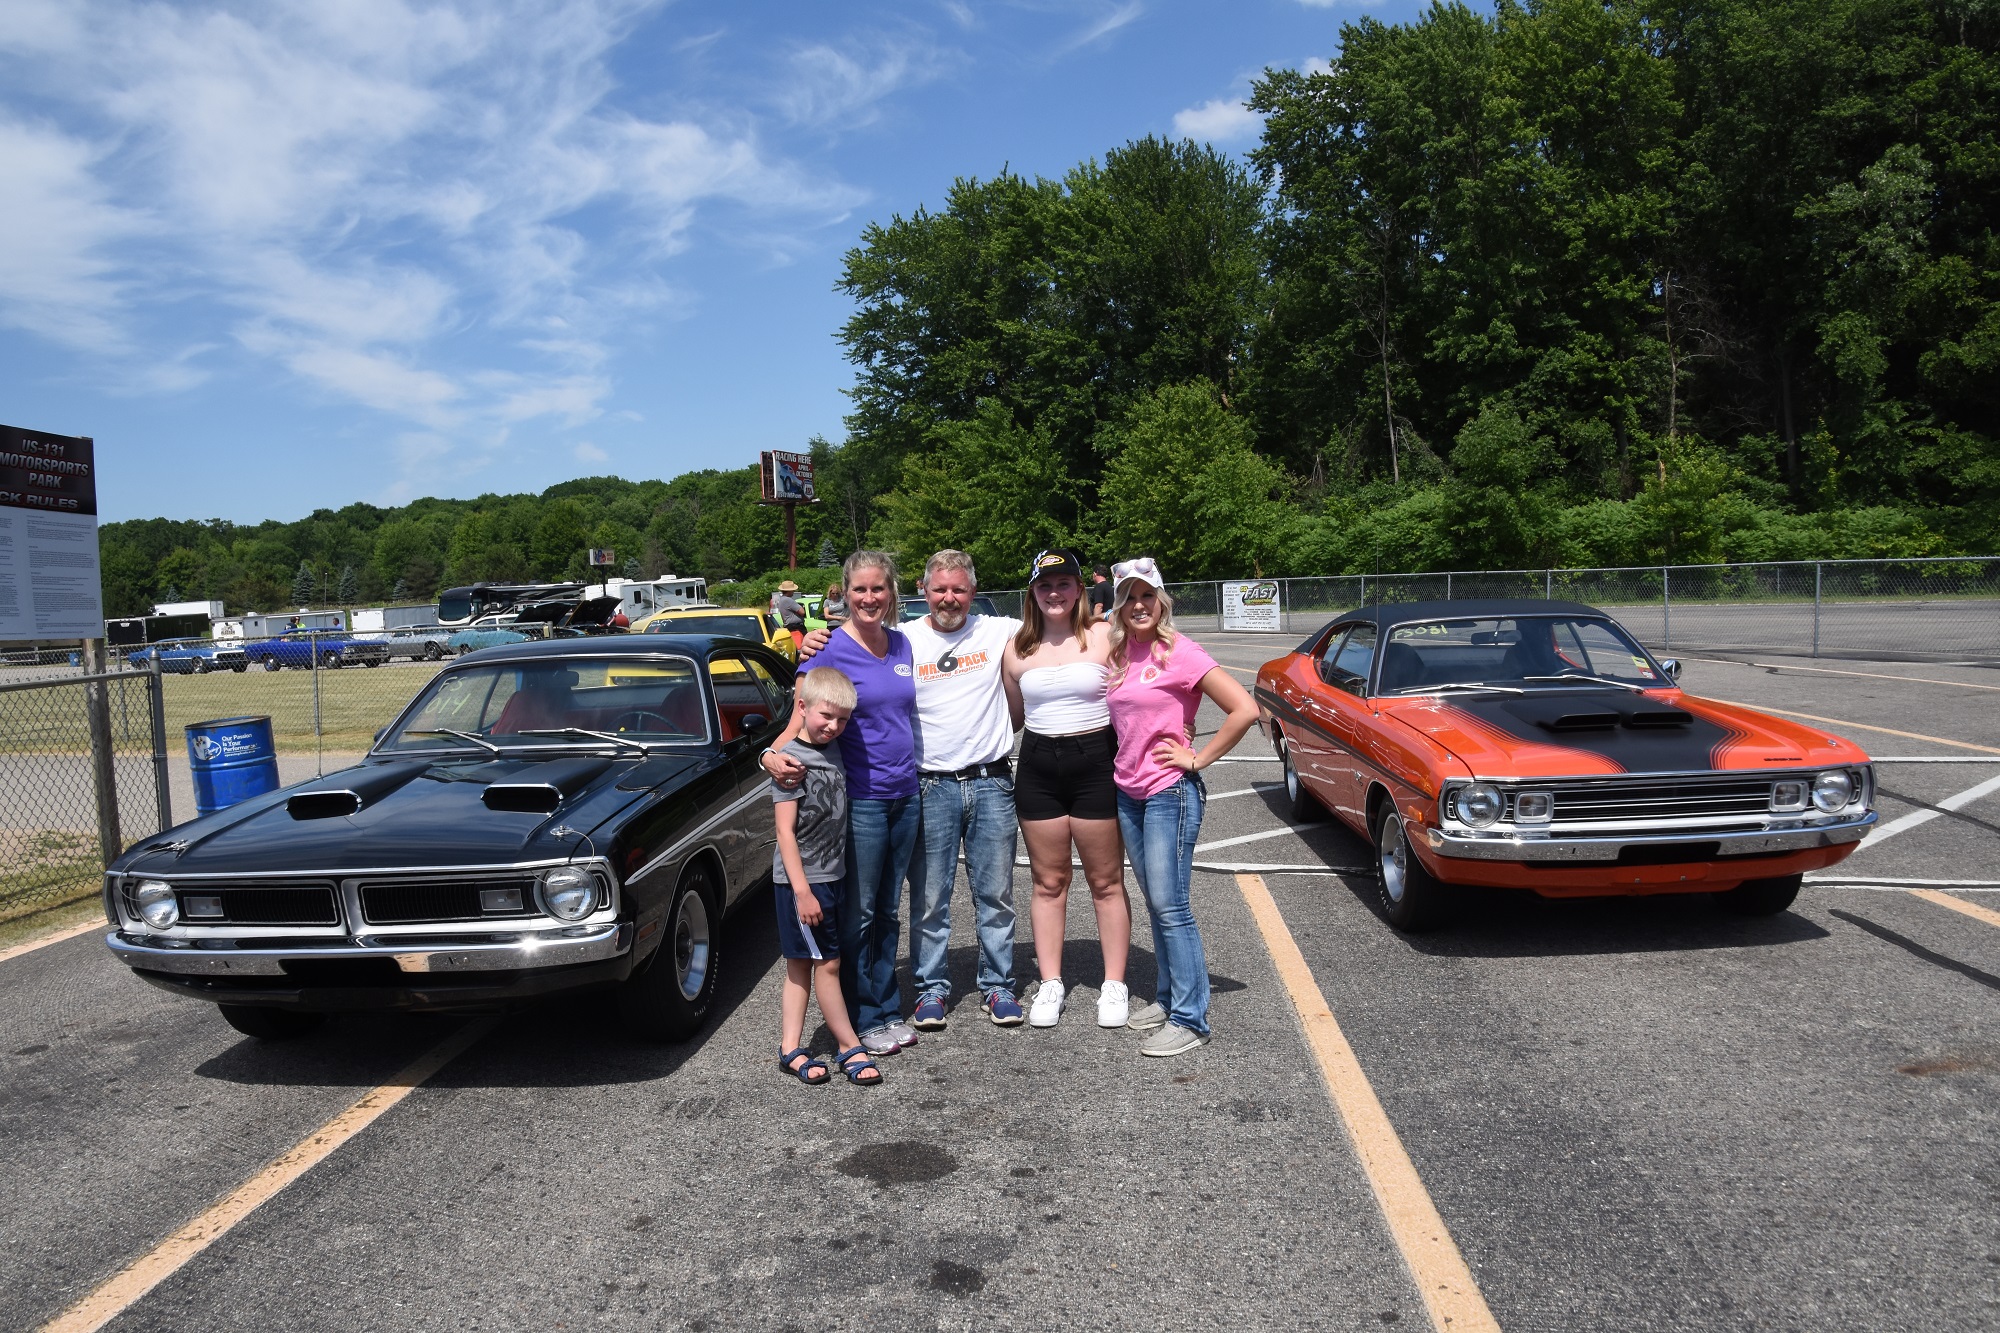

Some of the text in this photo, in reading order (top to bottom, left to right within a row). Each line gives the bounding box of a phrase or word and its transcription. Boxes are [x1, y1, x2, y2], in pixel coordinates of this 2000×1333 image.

[22, 439, 65, 457] US-131
[0, 452, 89, 477] MOTORSPORTS
[775, 452, 812, 465] RACING HERE
[28, 472, 63, 488] PARK
[796, 471, 813, 479] OCTOBER
[26, 494, 79, 509] RULES
[1244, 587, 1276, 600] FAST
[937, 648, 959, 673] 6
[957, 651, 988, 668] PACK
[923, 663, 984, 681] Racing Engines
[438, 676, 468, 692] FS
[425, 693, 471, 715] 014
